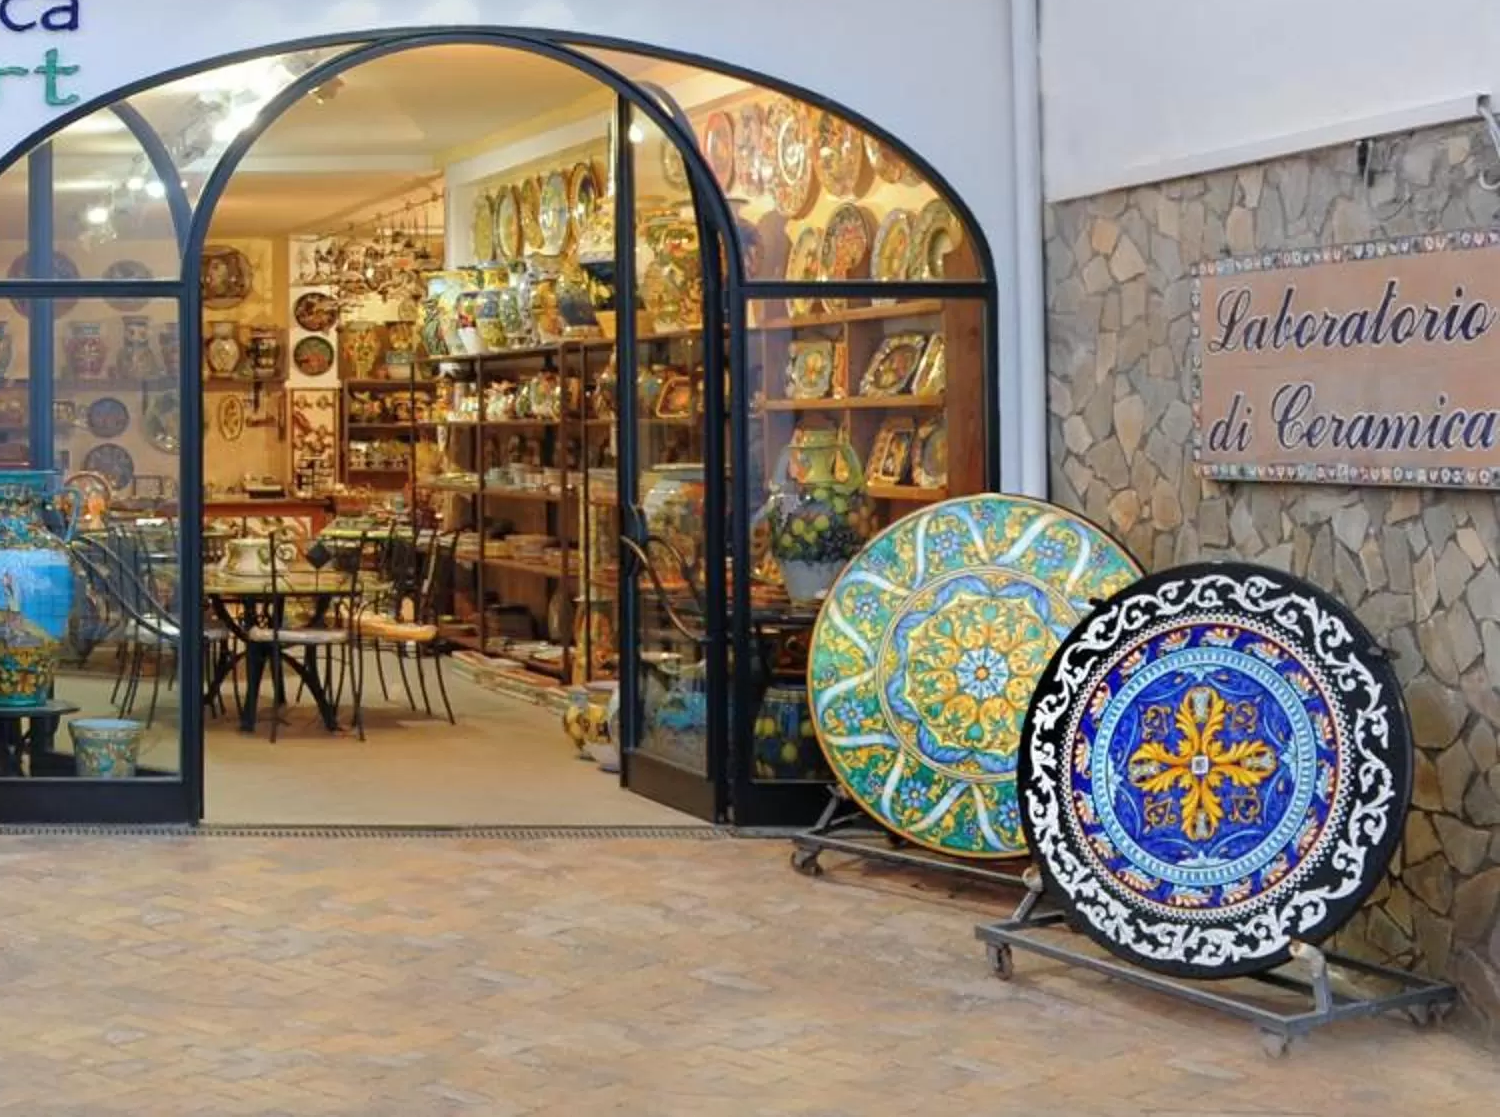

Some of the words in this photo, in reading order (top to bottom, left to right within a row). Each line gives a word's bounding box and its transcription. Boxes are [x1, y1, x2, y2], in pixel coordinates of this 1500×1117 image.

[1207, 279, 1496, 353] Laboratorio
[1208, 394, 1253, 452] di
[1272, 384, 1500, 451] Ceramica
